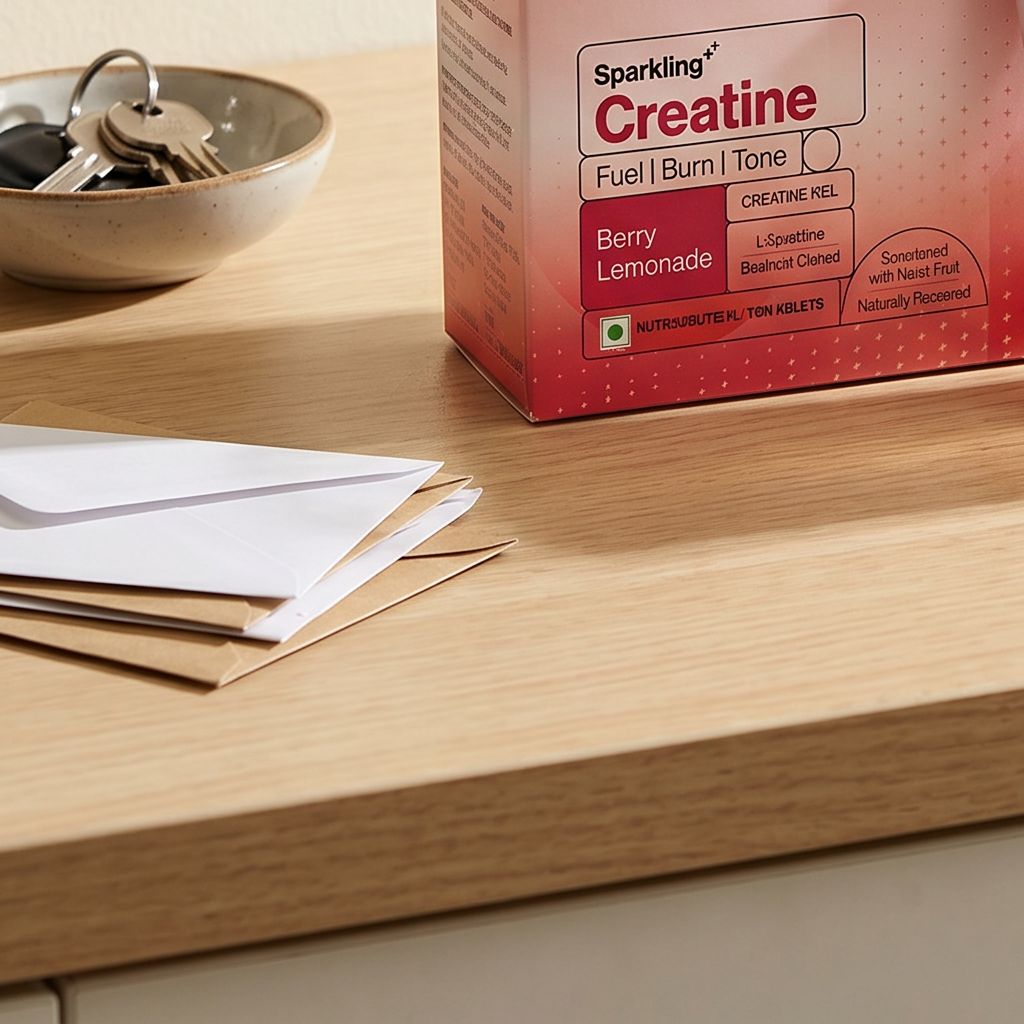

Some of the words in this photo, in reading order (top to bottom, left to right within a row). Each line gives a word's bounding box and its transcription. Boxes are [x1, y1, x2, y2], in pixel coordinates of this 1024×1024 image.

[595, 79, 817, 144] Creatine
[596, 161, 643, 188] Fuel
[662, 156, 714, 181] Burn
[731, 148, 787, 172] Tone
[741, 187, 808, 208] CREATINE
[597, 227, 657, 251] Berry
[597, 247, 713, 282] Lemonade
[868, 269, 895, 285] with
[933, 260, 960, 276] Fruit
[857, 293, 911, 313] Naturally
